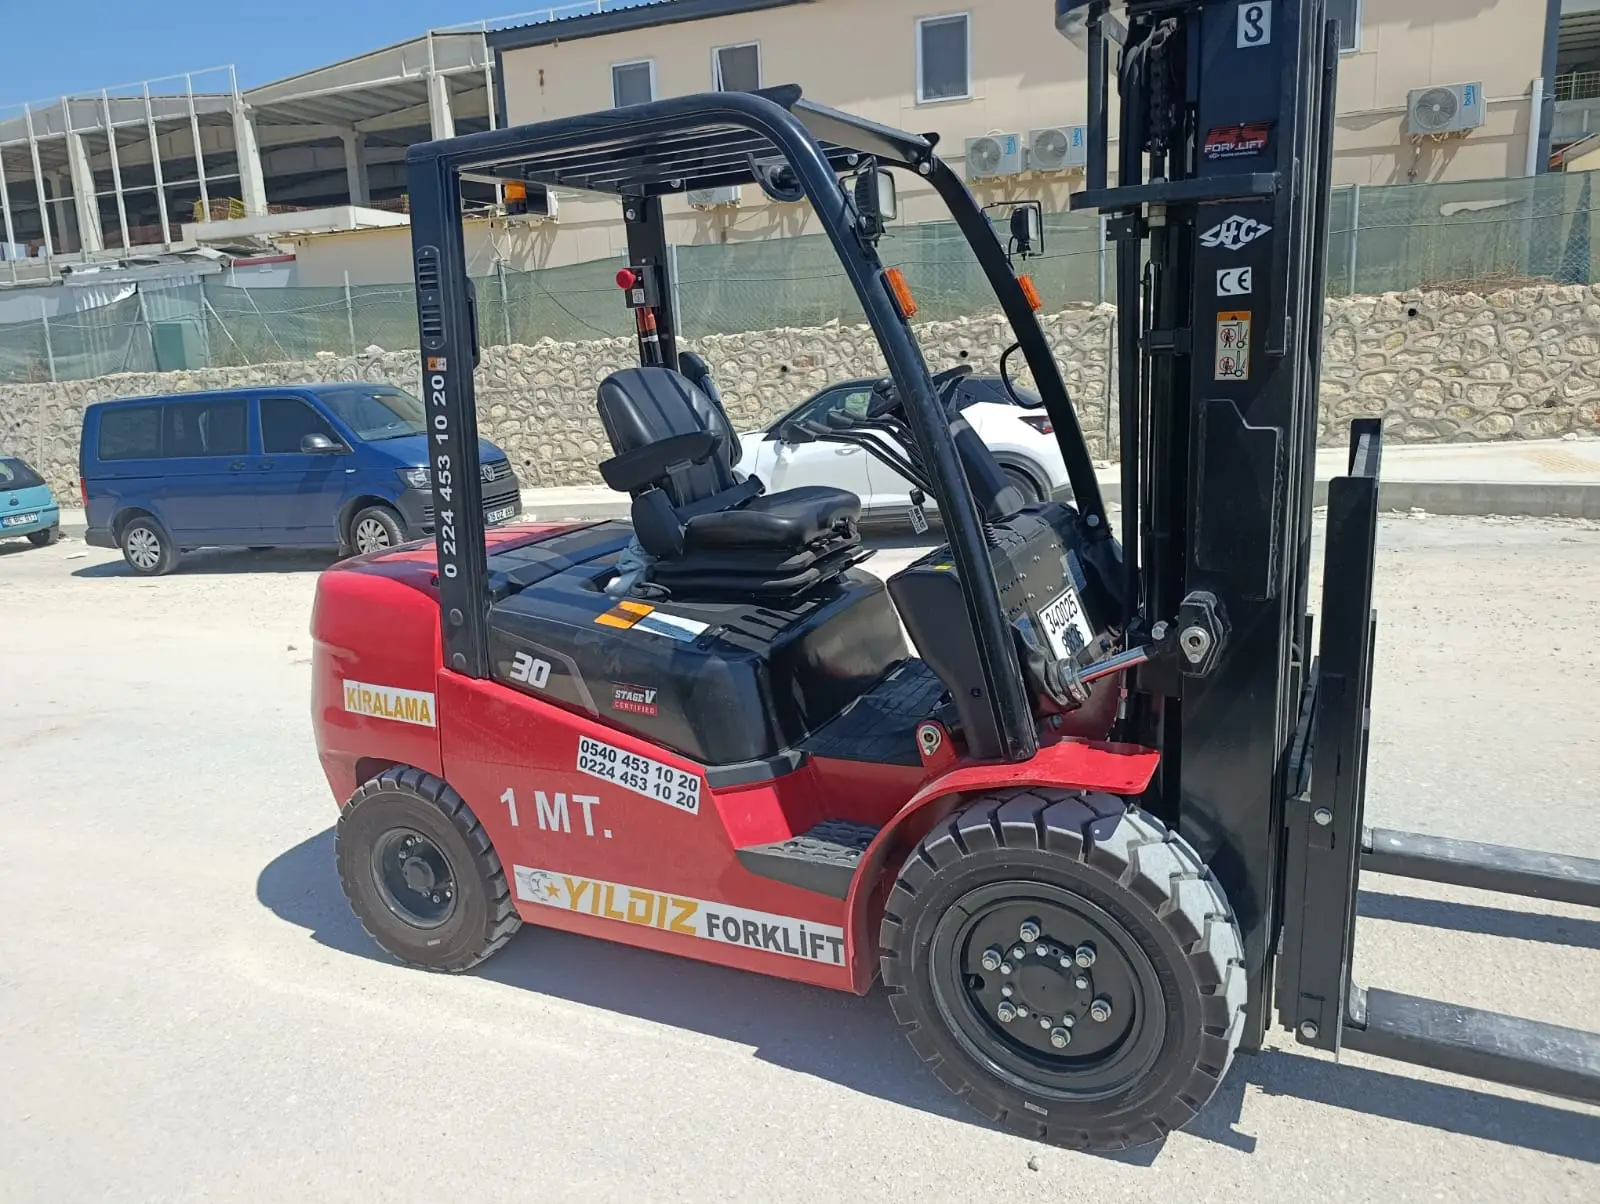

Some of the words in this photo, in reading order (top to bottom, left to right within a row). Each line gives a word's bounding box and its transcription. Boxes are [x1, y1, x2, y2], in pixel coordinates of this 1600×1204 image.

[1219, 270, 1250, 293] CE
[431, 374, 446, 406] 20
[435, 415, 449, 445] 10
[439, 453, 453, 502] 453
[442, 509, 456, 556] 224
[444, 563, 458, 578] 0
[1045, 593, 1078, 635] 340025
[510, 651, 551, 689] 30
[345, 683, 431, 723] KİRALAMA
[615, 689, 645, 702] STAGE
[645, 689, 657, 704] V
[615, 701, 655, 714] CERTIFIED
[579, 756, 615, 779] 0224
[619, 771, 648, 791] 453
[653, 783, 672, 800] 10
[676, 791, 696, 809] 20
[581, 740, 617, 763] 0540
[621, 755, 650, 775] 453
[655, 767, 674, 783] 10
[678, 775, 698, 792] 20
[500, 787, 519, 827] 1
[534, 790, 613, 839] MT.
[562, 876, 701, 936] YILDIZ
[706, 912, 844, 963] FORKLİFT
